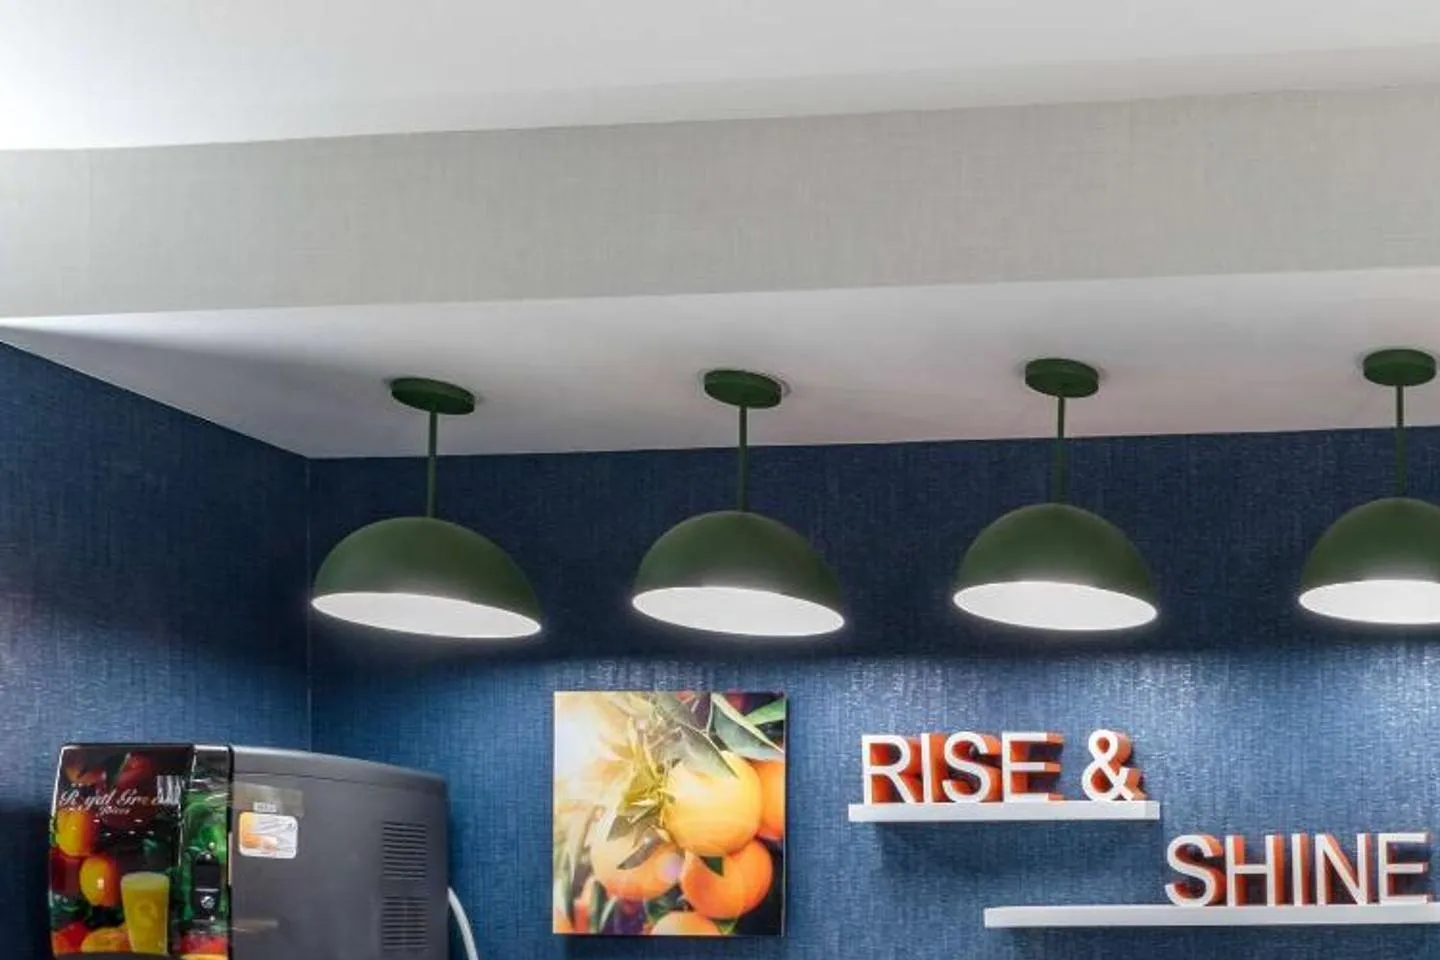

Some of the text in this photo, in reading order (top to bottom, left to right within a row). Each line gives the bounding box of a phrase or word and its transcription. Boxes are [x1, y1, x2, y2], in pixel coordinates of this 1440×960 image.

[861, 729, 1142, 804] RISE &
[1164, 832, 1431, 907] SHINE
